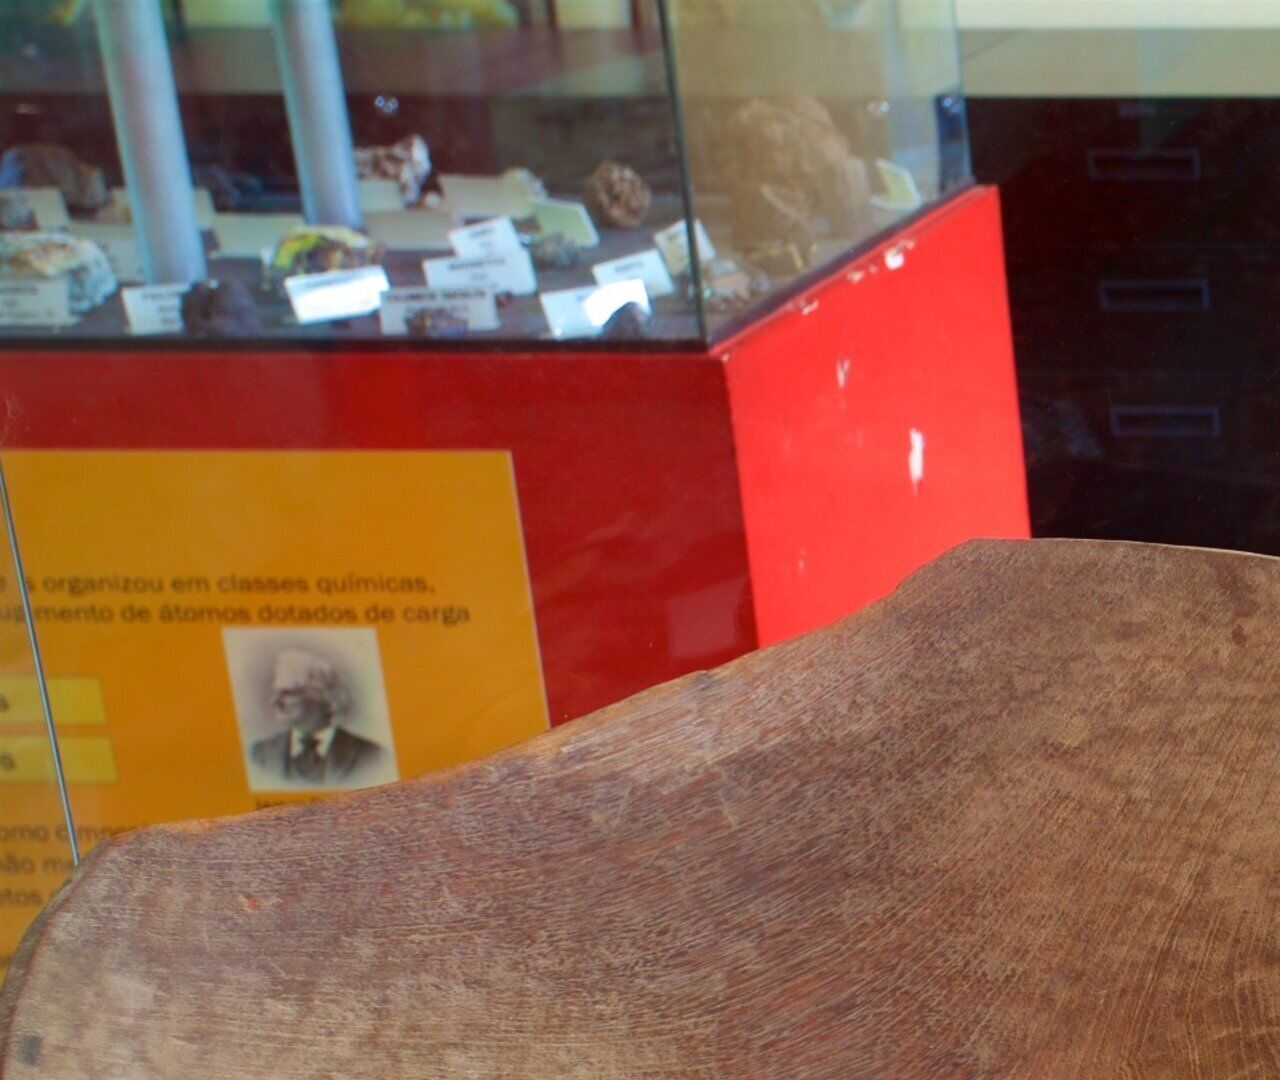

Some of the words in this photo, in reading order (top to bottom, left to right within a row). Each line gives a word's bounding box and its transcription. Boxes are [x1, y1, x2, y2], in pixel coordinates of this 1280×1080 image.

[42, 573, 164, 598] organizou
[170, 577, 211, 593] em
[217, 574, 309, 593] classes
[316, 573, 436, 595] químicas,
[120, 604, 151, 623] de
[159, 602, 252, 623] átomos
[257, 603, 358, 623] dotados
[364, 603, 395, 623] de
[402, 606, 471, 628] carga
